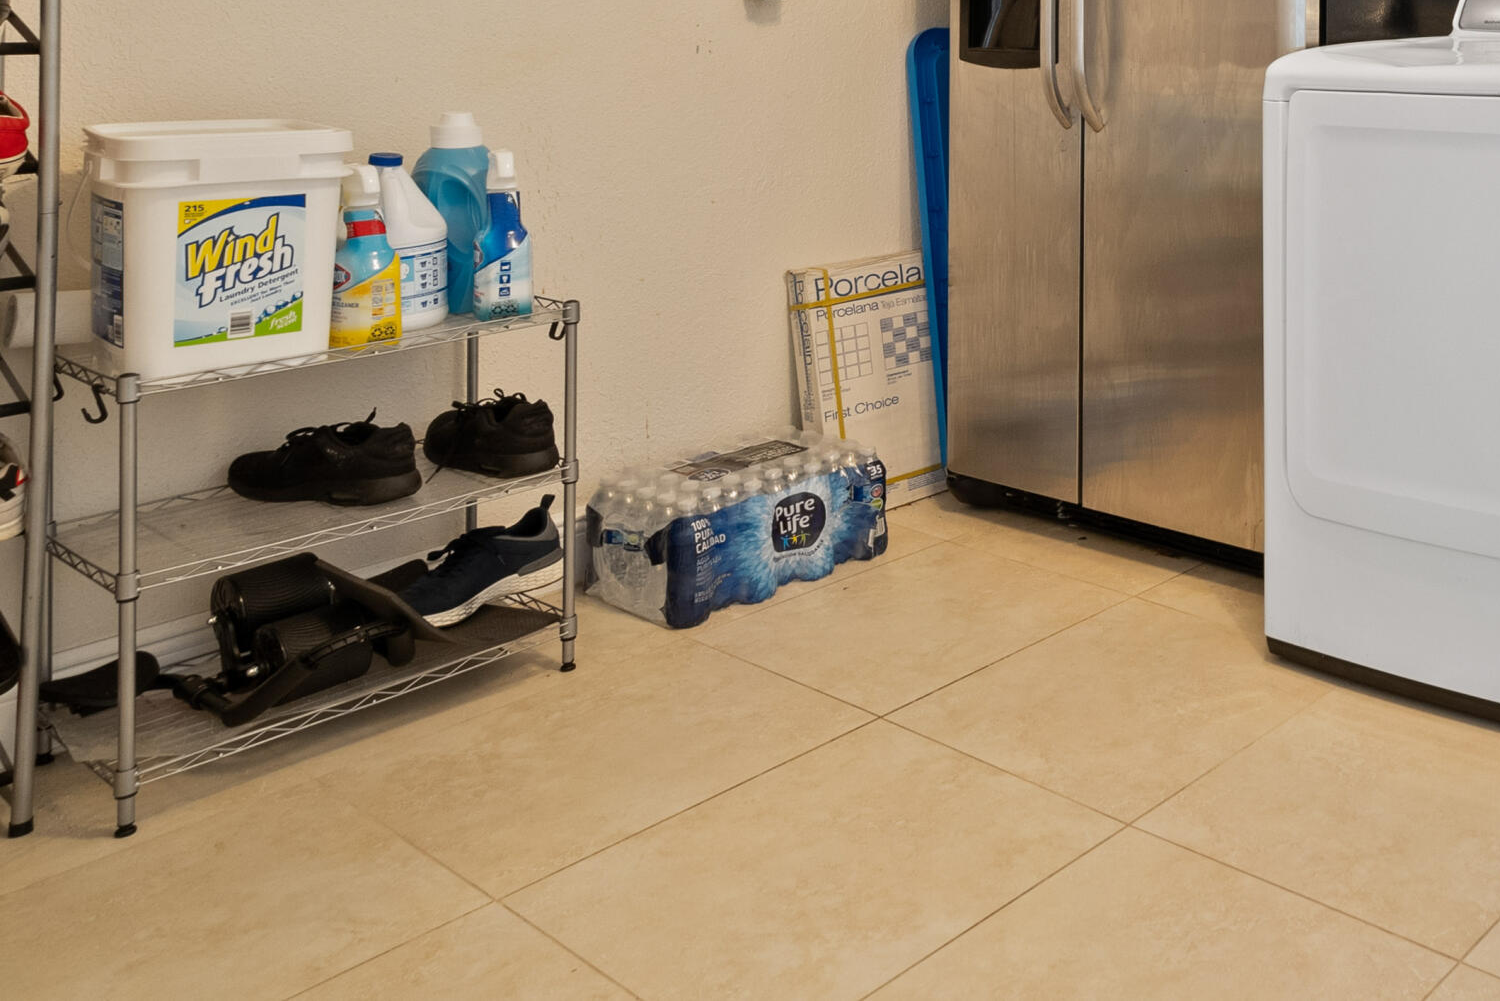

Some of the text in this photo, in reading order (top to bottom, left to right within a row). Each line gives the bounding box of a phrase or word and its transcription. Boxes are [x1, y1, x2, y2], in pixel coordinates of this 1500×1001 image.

[184, 204, 205, 213] 215
[186, 212, 280, 281] Wind
[196, 234, 295, 309] Fresh
[219, 268, 299, 303] Laundry Detergent
[795, 280, 813, 367] Pocelain
[854, 394, 900, 416] Choice
[775, 497, 816, 523] Pure
[779, 513, 811, 536] Life
